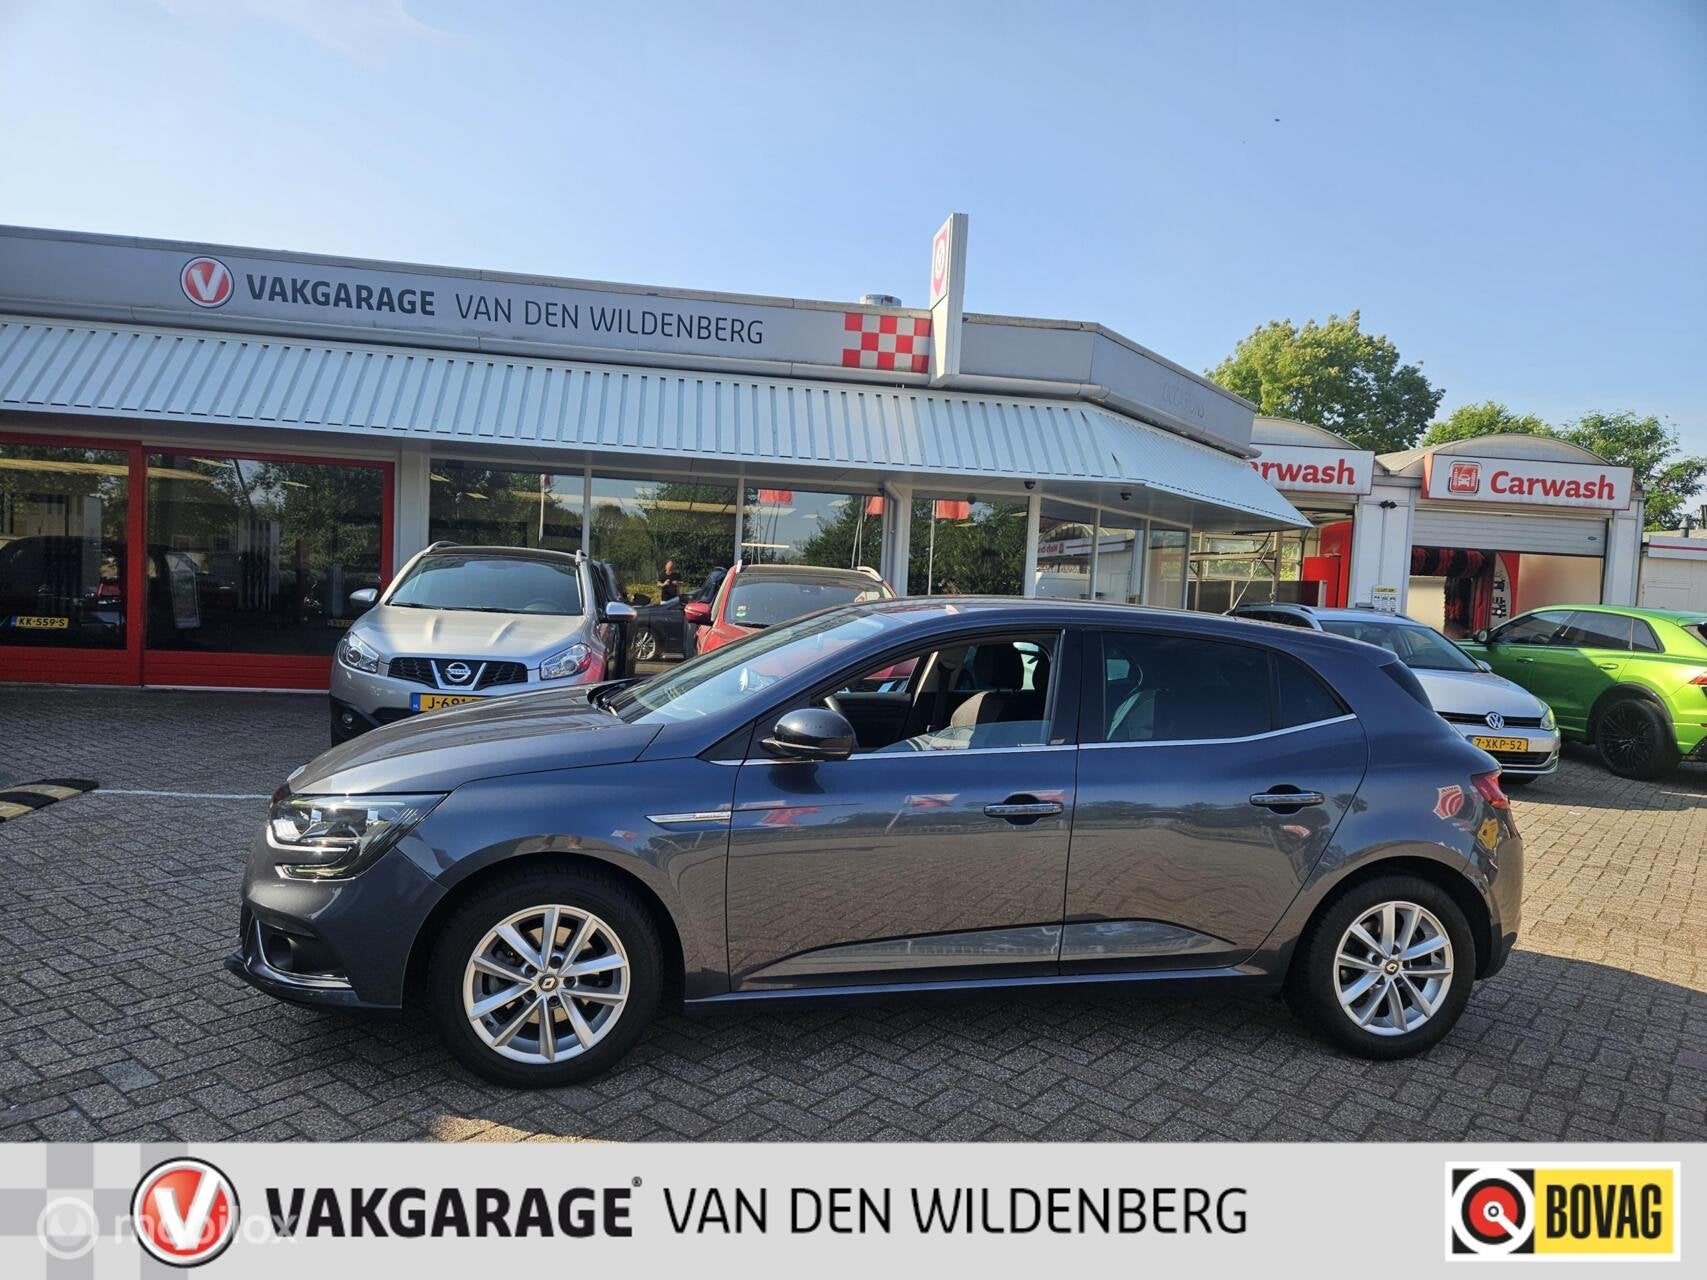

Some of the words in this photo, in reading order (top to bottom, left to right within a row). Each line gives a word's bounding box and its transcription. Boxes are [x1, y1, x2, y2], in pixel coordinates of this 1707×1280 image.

[246, 273, 435, 316] VAKGARAGE
[455, 293, 512, 323] VAN
[524, 300, 579, 329] DEN
[589, 305, 763, 344] WILDENBERG
[1250, 458, 1356, 485] rwash
[1490, 470, 1615, 500] Carwash
[1475, 738, 1522, 750] 7-XKP-52
